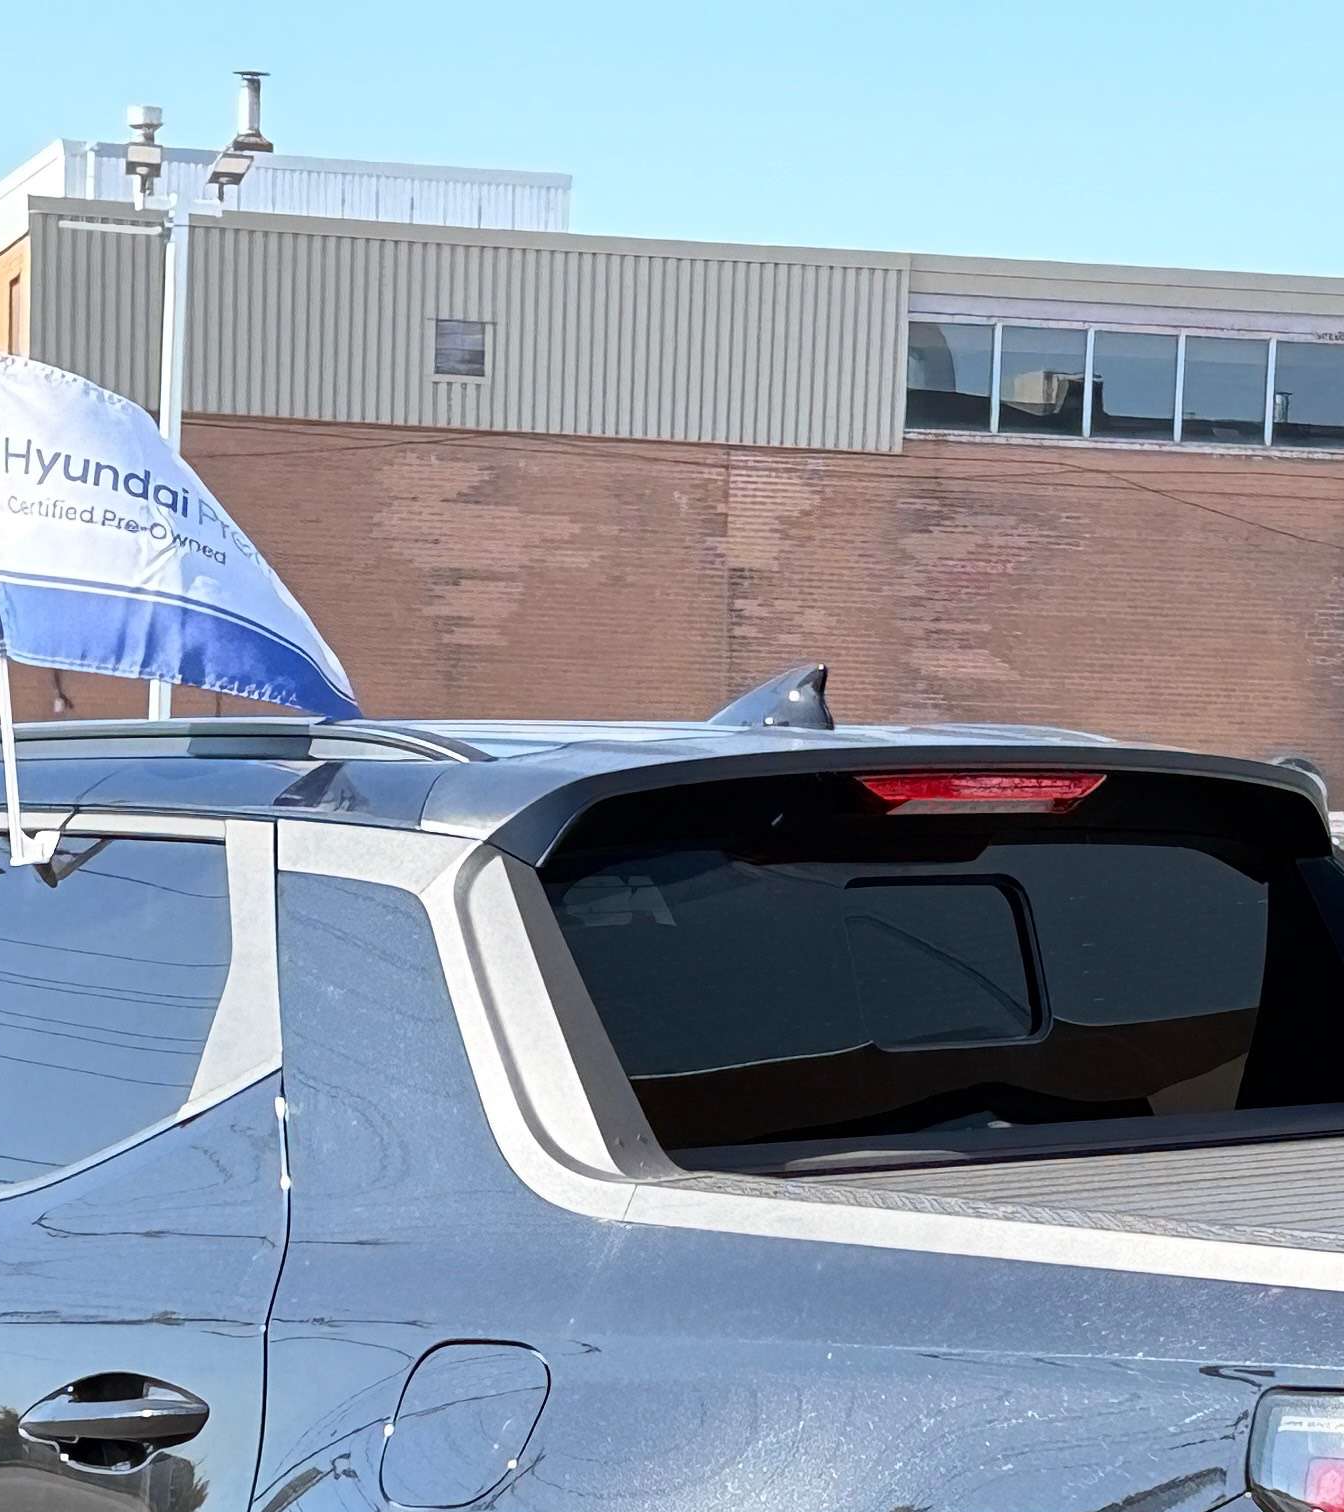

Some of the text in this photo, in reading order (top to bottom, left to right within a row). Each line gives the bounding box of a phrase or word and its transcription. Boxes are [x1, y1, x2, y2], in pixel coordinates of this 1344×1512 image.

[3, 436, 189, 518] Hyundai
[7, 496, 226, 566] Certified Pre-Owned
